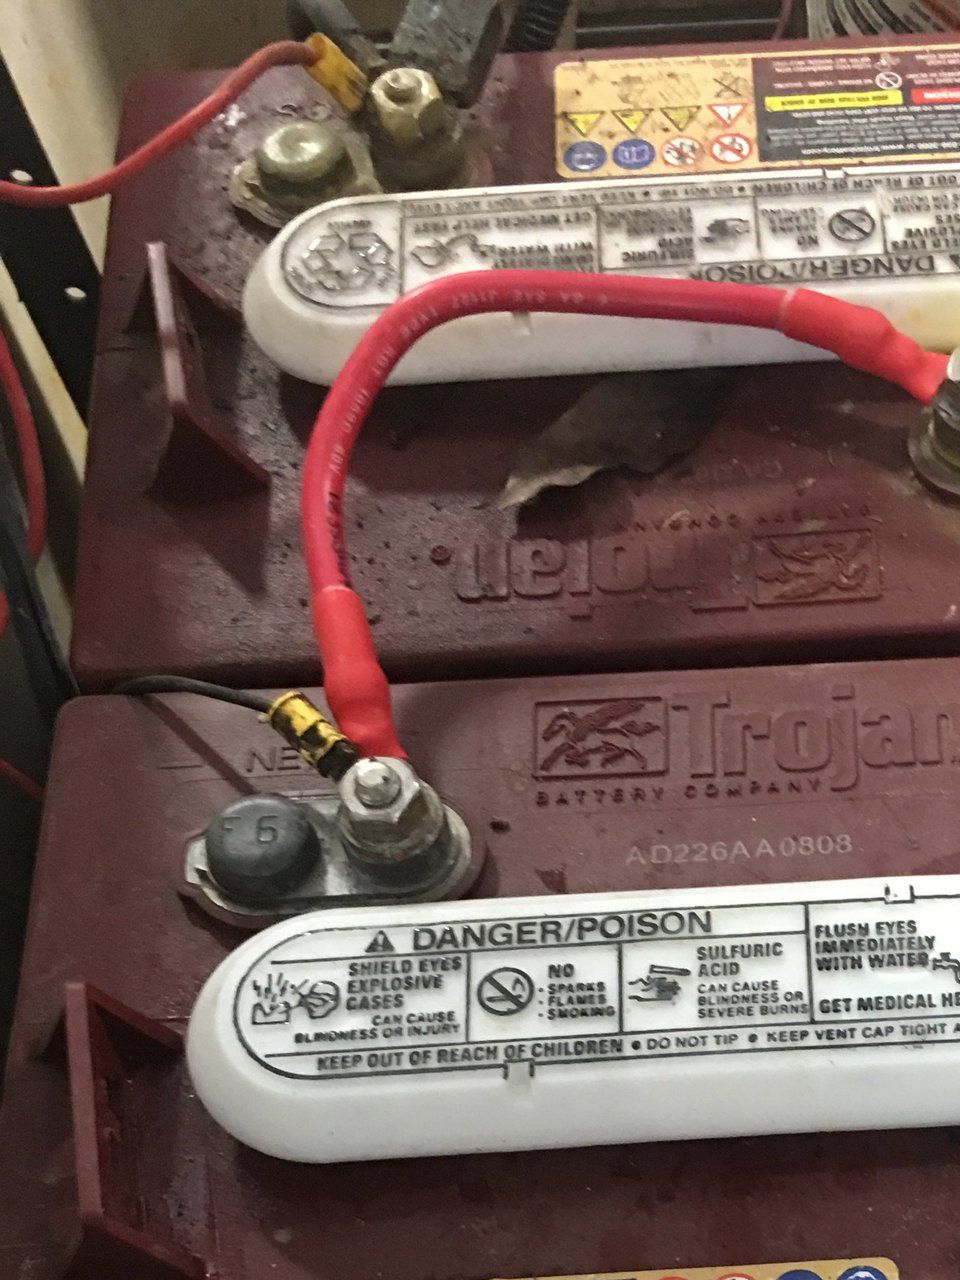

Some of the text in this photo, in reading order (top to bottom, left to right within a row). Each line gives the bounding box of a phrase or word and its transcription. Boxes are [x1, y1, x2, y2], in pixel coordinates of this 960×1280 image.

[245, 746, 302, 773] NE
[537, 779, 821, 807] BATTERY COMPANY
[413, 910, 713, 952] DANGER/POISON
[815, 919, 919, 938] FLUSH EYES
[696, 941, 784, 961] SULFURIC
[814, 935, 936, 954] IMMEDIATELY
[348, 955, 463, 977] SHIELD EYES
[548, 963, 575, 979] NO
[697, 960, 740, 978] ACID
[815, 951, 930, 972] WITH WATER
[346, 973, 444, 994] EXPLOSIVE
[697, 979, 779, 995] CAN CAUSE
[345, 992, 404, 1011] GASES
[697, 990, 805, 1006] BLINDNESS OR
[819, 997, 858, 1014] GET
[861, 994, 938, 1012] MEDICAL
[371, 1010, 456, 1027] CAN CAUSE
[697, 1002, 809, 1019] SEVERE BURNS
[383, 1024, 403, 1039] OR
[406, 1022, 461, 1038] INJURY
[317, 1053, 363, 1072] KEEP
[366, 1051, 404, 1068] OUT
[408, 1049, 433, 1066] OF
[436, 1045, 498, 1063] REACH
[503, 1043, 529, 1060] OF
[530, 1038, 624, 1058] CHILDREN
[646, 1036, 668, 1051] DO
[671, 1034, 710, 1049] NOT
[712, 1032, 740, 1046] TIP
[767, 1028, 810, 1043] KEEP
[815, 1026, 859, 1041] VENT
[861, 1024, 896, 1039] CAP
[900, 1022, 948, 1037] TIGHT
